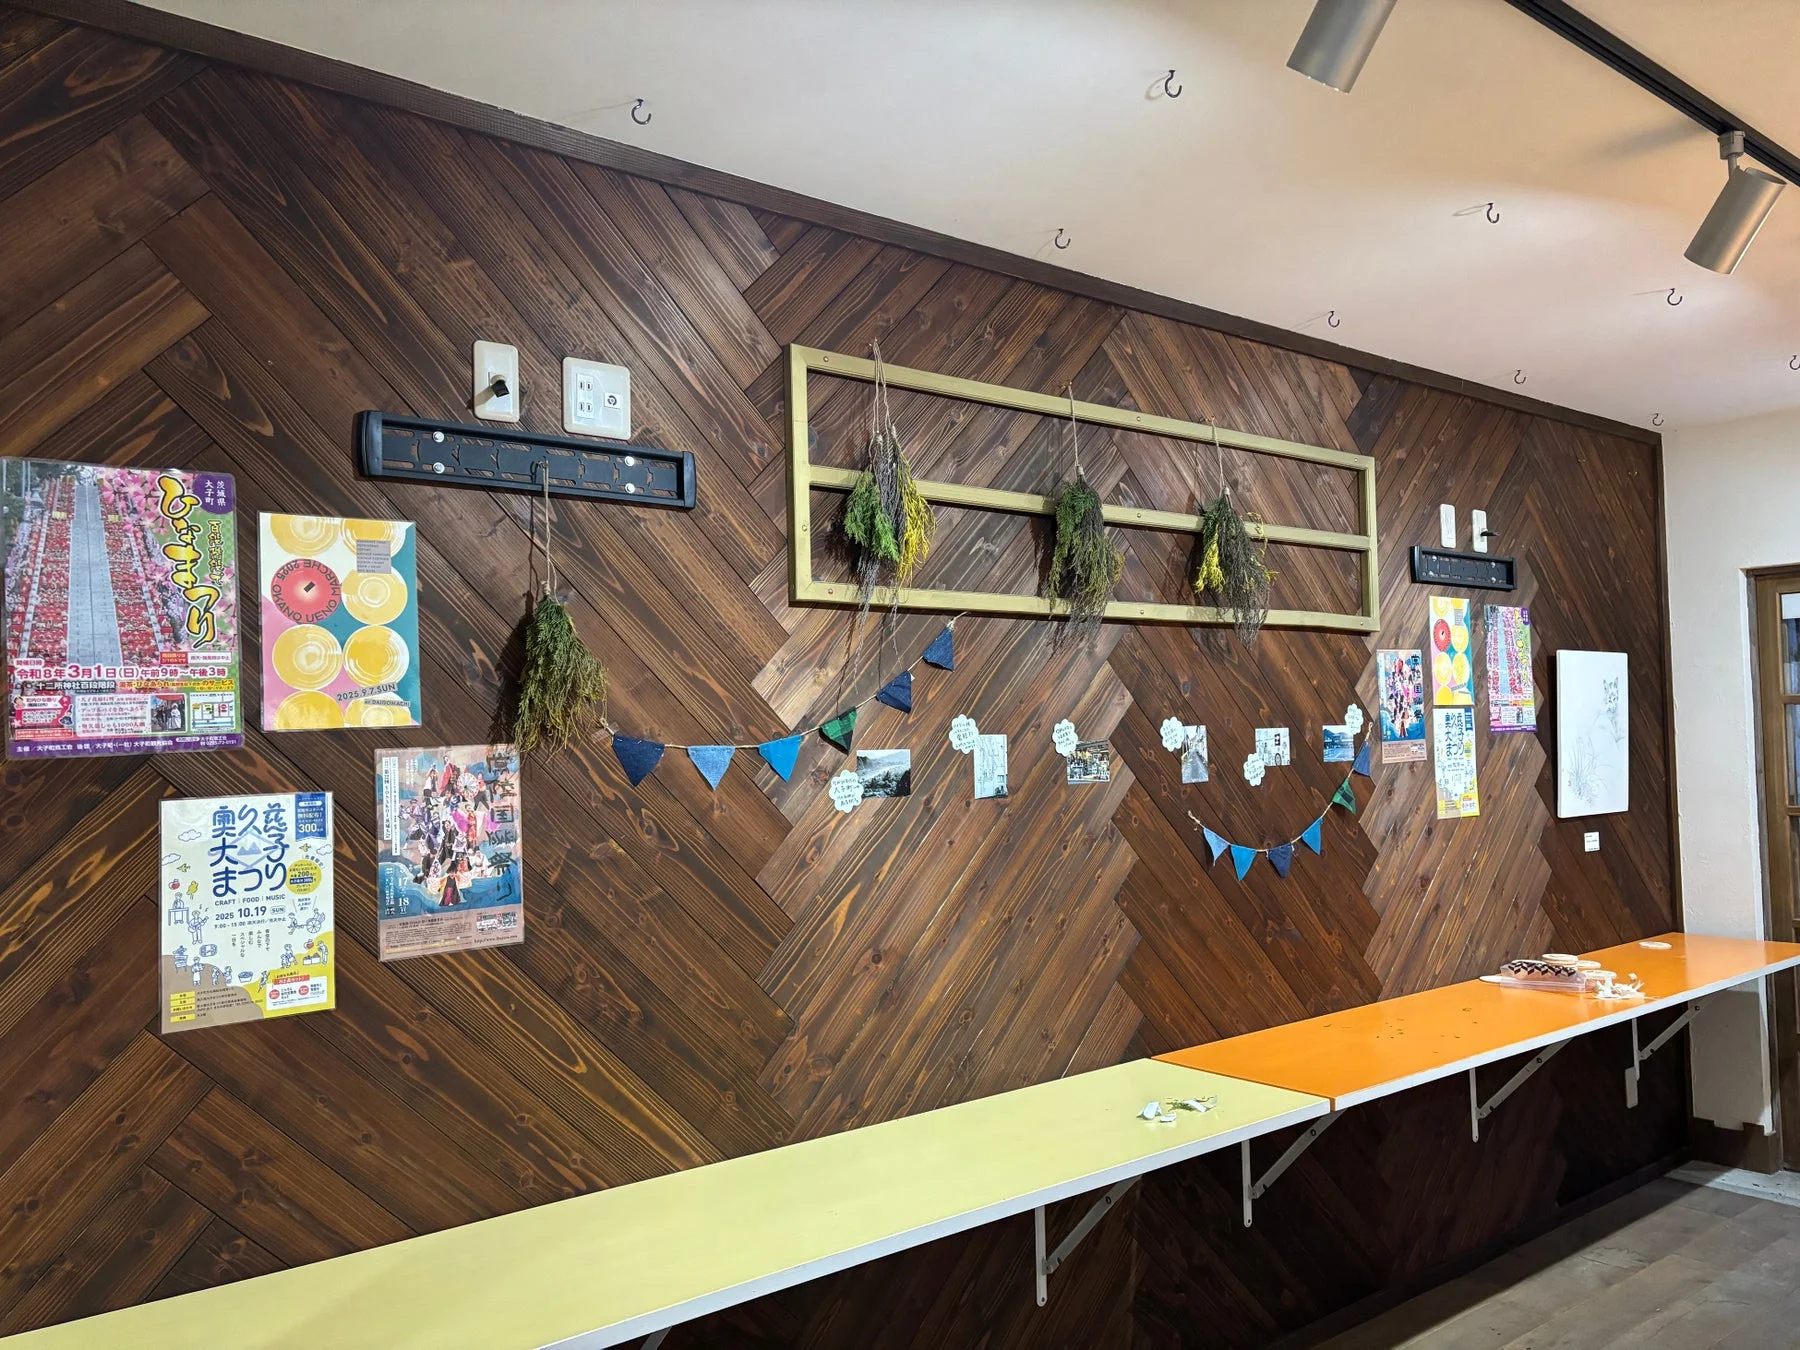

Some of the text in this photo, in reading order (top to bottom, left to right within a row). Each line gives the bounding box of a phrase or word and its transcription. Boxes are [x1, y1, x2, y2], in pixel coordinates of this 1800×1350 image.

[204, 480, 215, 507] 大子町
[216, 480, 227, 507] 茨城県
[157, 475, 220, 648] ひなまつり
[275, 560, 300, 580] 2025
[303, 559, 341, 596] MARCHE
[306, 599, 337, 623] UENO
[212, 803, 288, 839] 奥久慈
[298, 823, 317, 833] 300
[209, 834, 290, 867] 大子
[212, 862, 288, 898] まつり
[214, 893, 286, 906] CRAFT FOOD MUSIC
[215, 912, 235, 921] 2025
[237, 905, 267, 918] 10.19
[398, 897, 410, 907] 18
